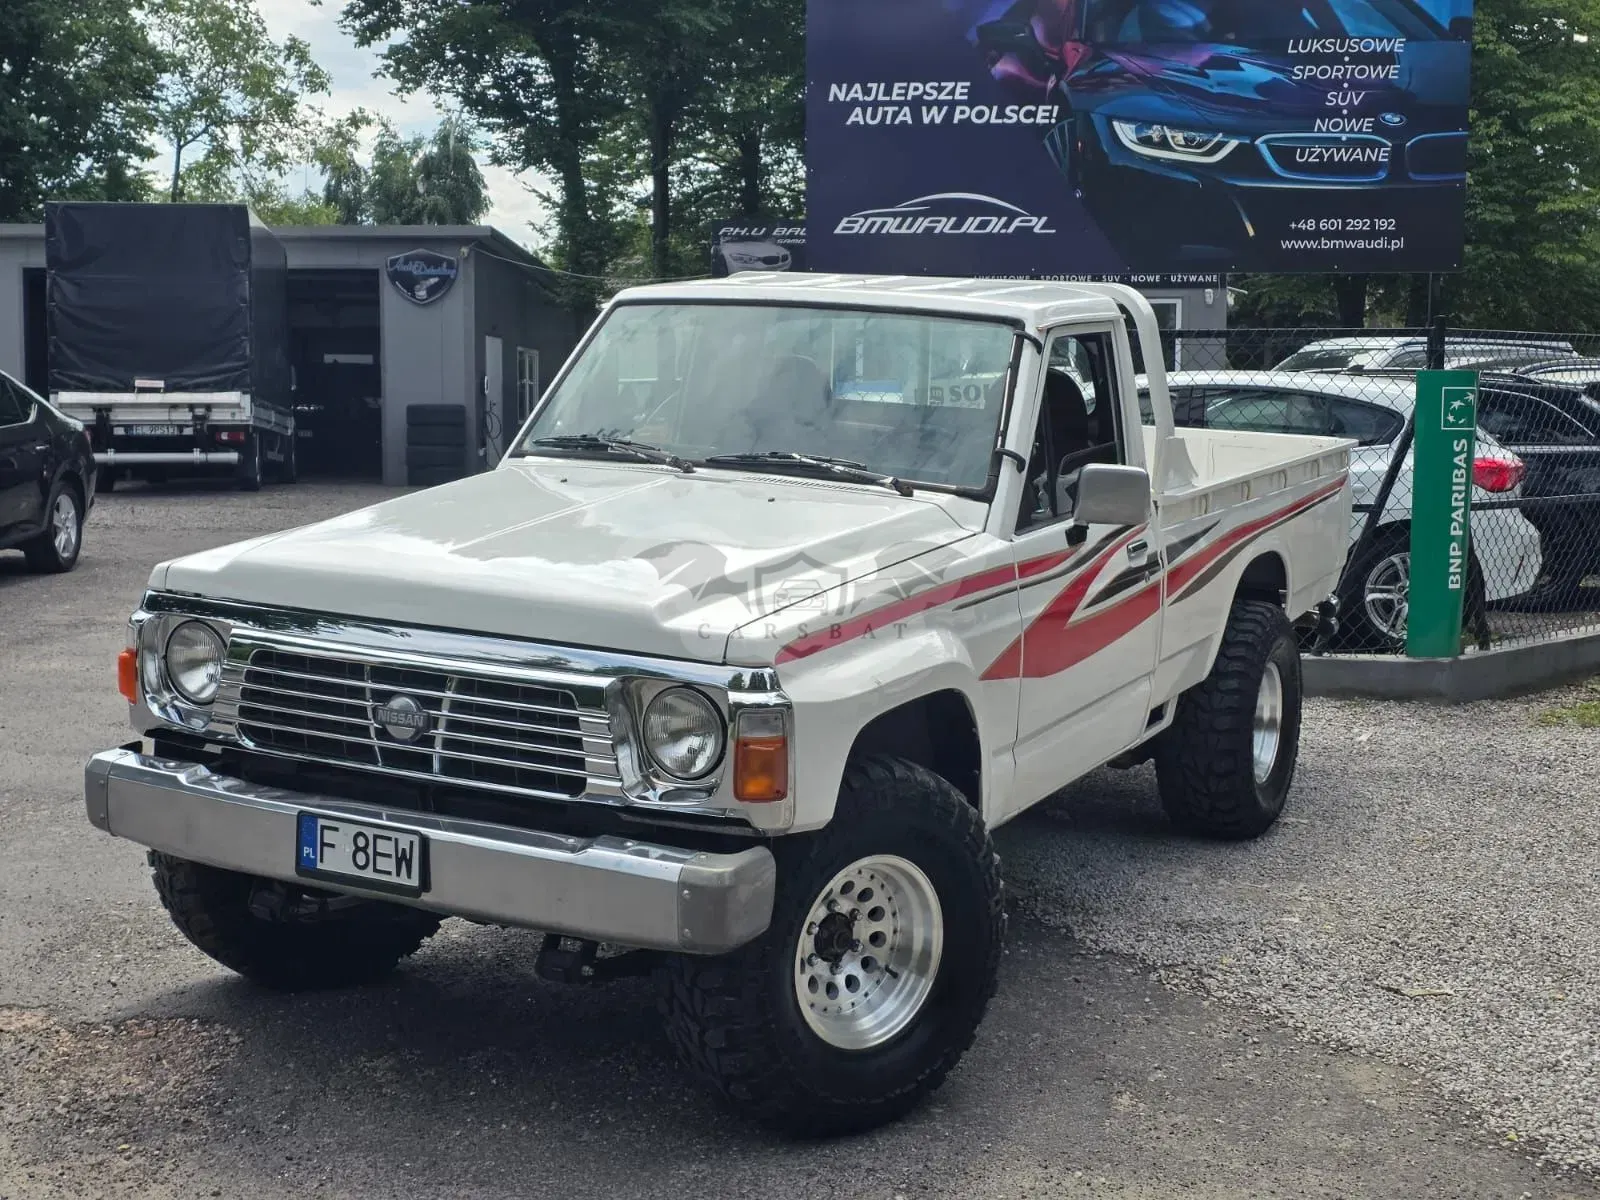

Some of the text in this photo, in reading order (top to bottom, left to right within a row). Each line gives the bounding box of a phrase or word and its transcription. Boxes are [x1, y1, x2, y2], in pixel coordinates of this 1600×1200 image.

[1288, 38, 1406, 53] LUKSUSOWE
[1291, 65, 1401, 80] SPORTOWE
[828, 81, 971, 102] NAJLEPSZE
[1325, 91, 1365, 106] SUV
[845, 105, 1059, 125] AUTA W POLSCE!
[1314, 118, 1375, 132] NOWE
[1296, 145, 1391, 162] UŻYWANE
[833, 216, 1057, 235] BMWAUDI.PL
[1289, 219, 1396, 231] +48 601 292 192
[1281, 237, 1405, 251] www.bmwaudi.pl
[1102, 274, 1120, 282] SUV
[1130, 274, 1161, 282] NOWE
[1170, 272, 1218, 283] UŻYWANE
[1448, 438, 1468, 589] BNP PARIBAS
[377, 708, 424, 728] NISSAN
[303, 846, 316, 859] PL
[319, 824, 414, 880] F 8EW
